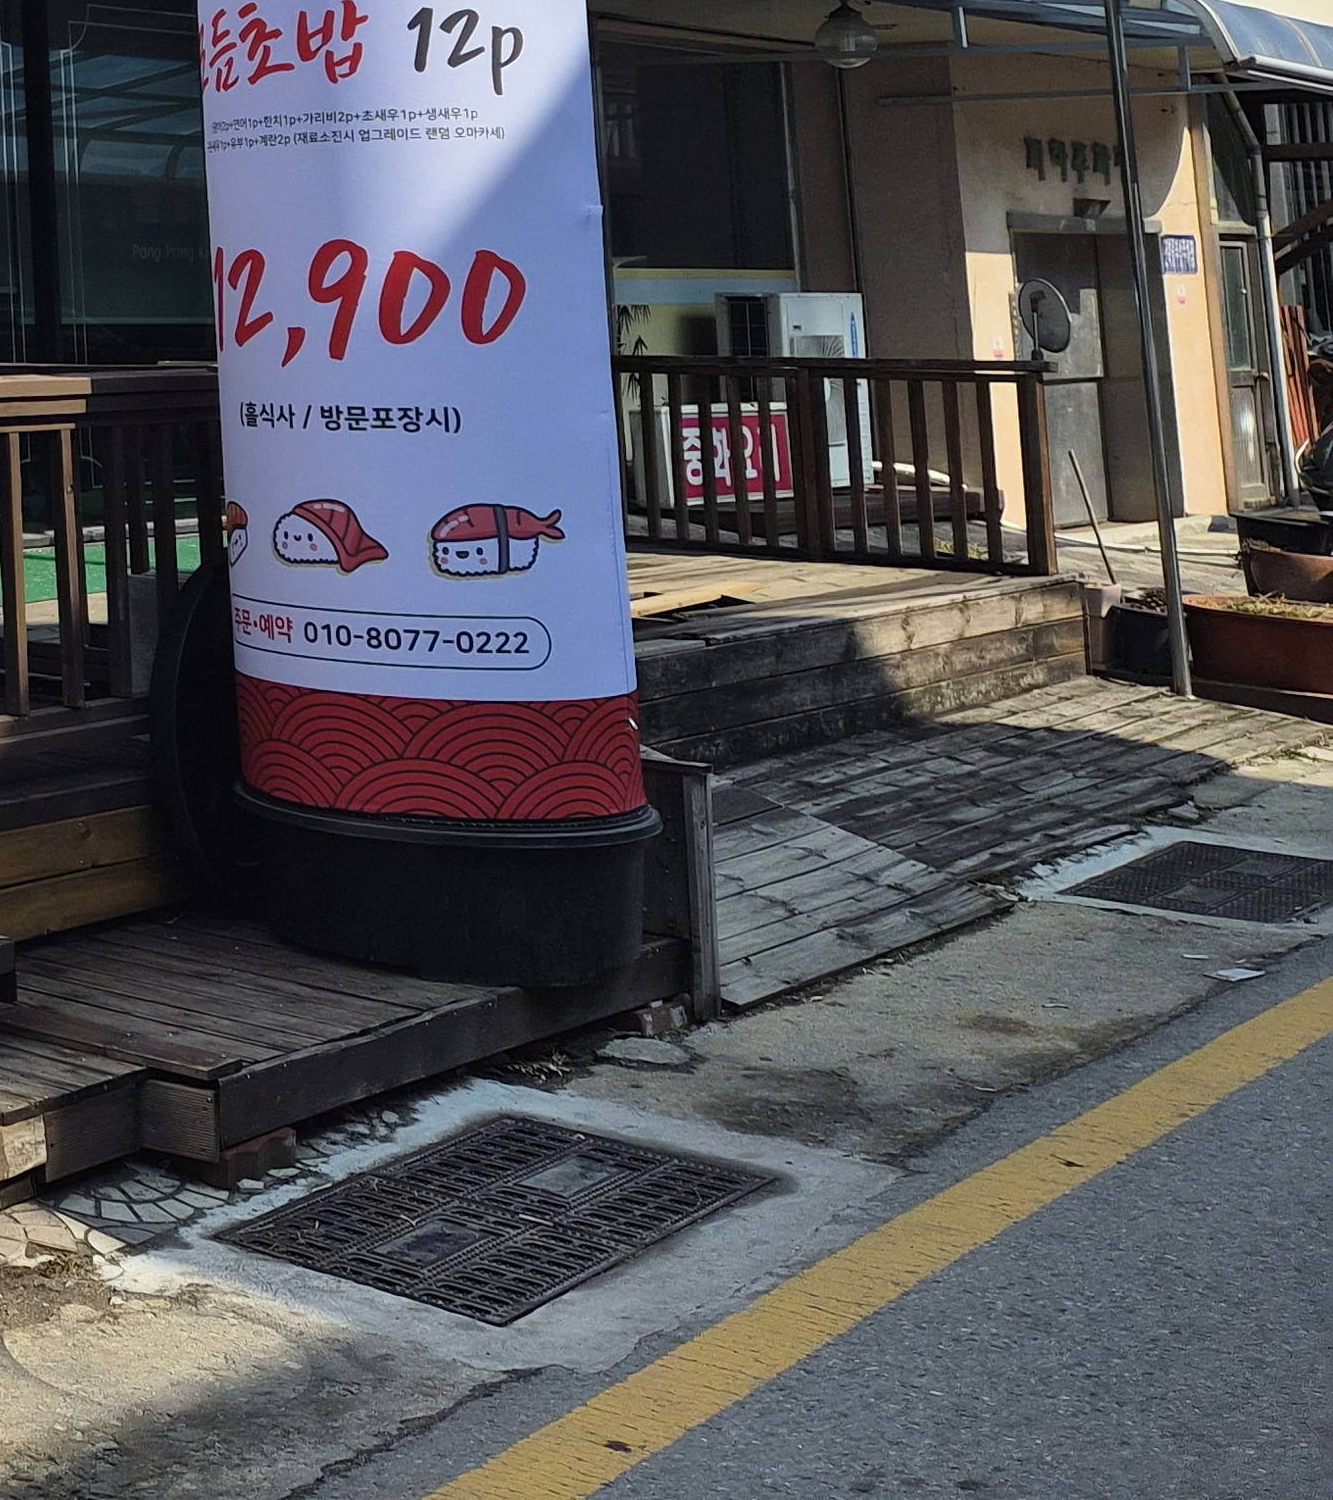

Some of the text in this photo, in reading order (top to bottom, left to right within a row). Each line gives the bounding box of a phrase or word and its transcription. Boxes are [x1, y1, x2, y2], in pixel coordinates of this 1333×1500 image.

[407, 6, 525, 96] 12p
[213, 238, 527, 368] 12,900
[319, 403, 462, 434] 방문포장시)
[303, 621, 531, 655] 010-8077-0222
